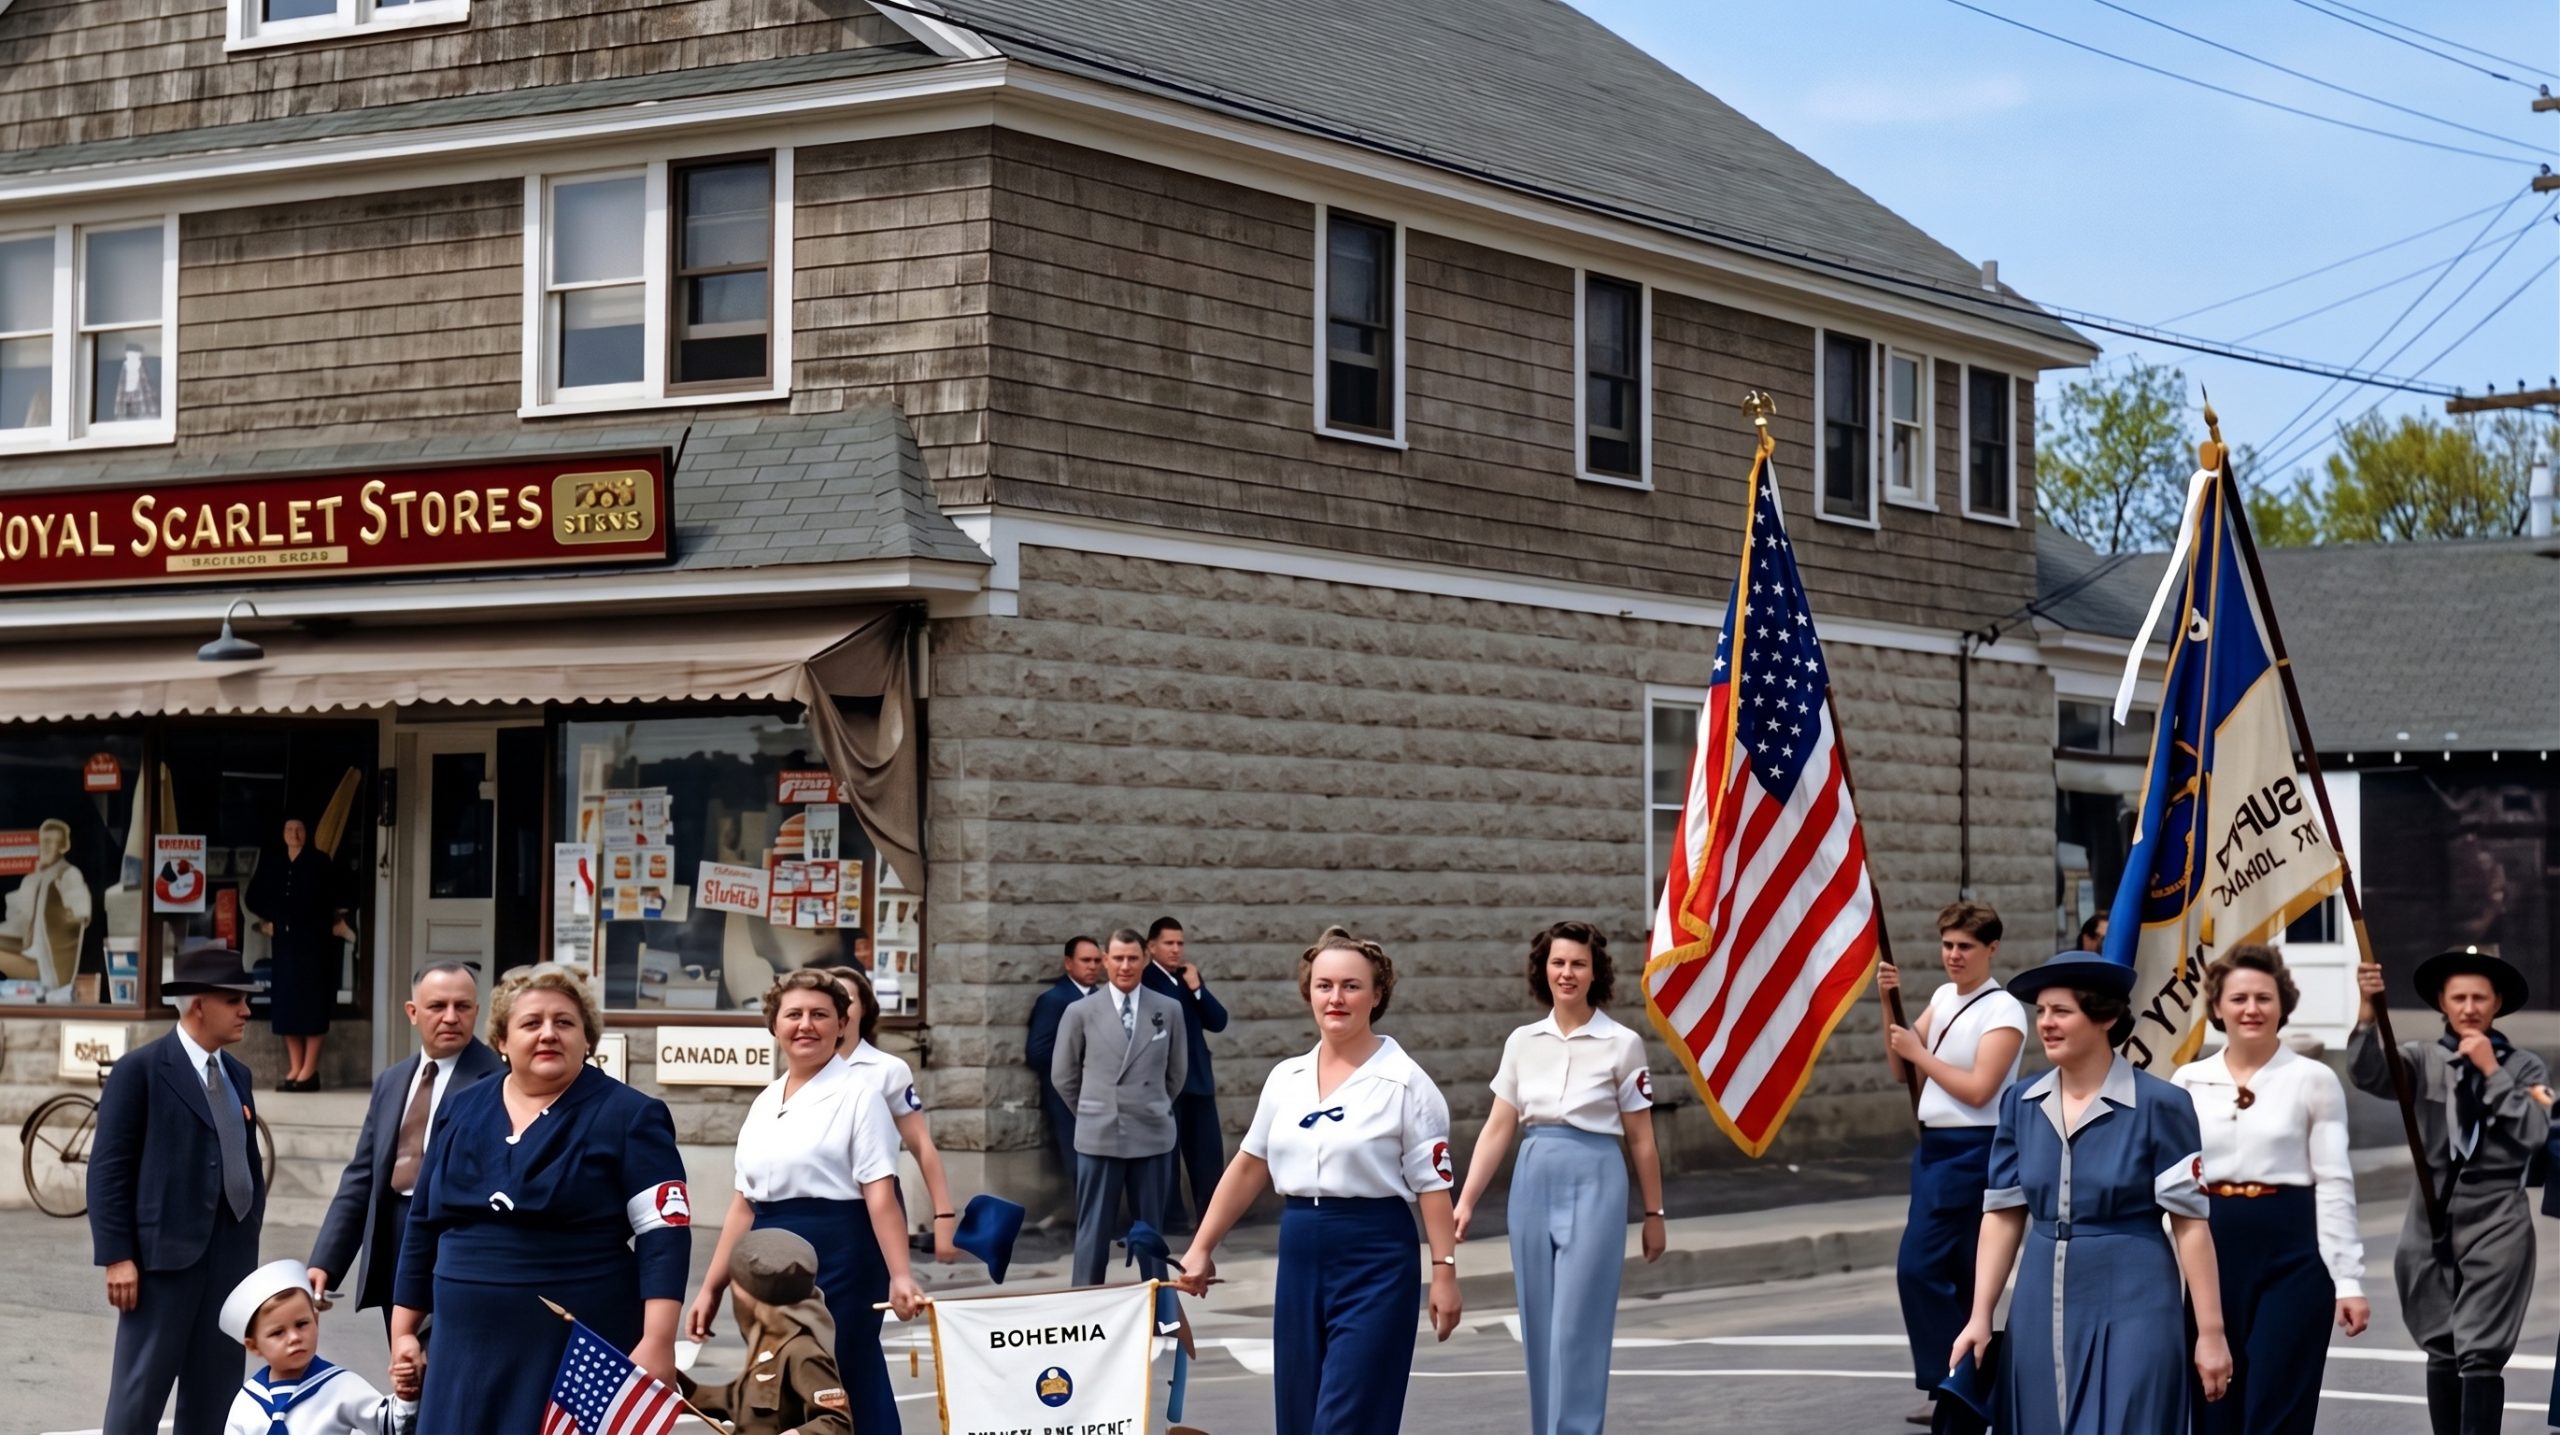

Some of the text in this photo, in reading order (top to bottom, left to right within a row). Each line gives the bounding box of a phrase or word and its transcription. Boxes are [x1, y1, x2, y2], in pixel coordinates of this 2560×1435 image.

[0, 480, 542, 560] OYAL SCARLET STORES
[661, 1046, 770, 1065] CANADA DE
[990, 1324, 1106, 1348] BOHEMIA
